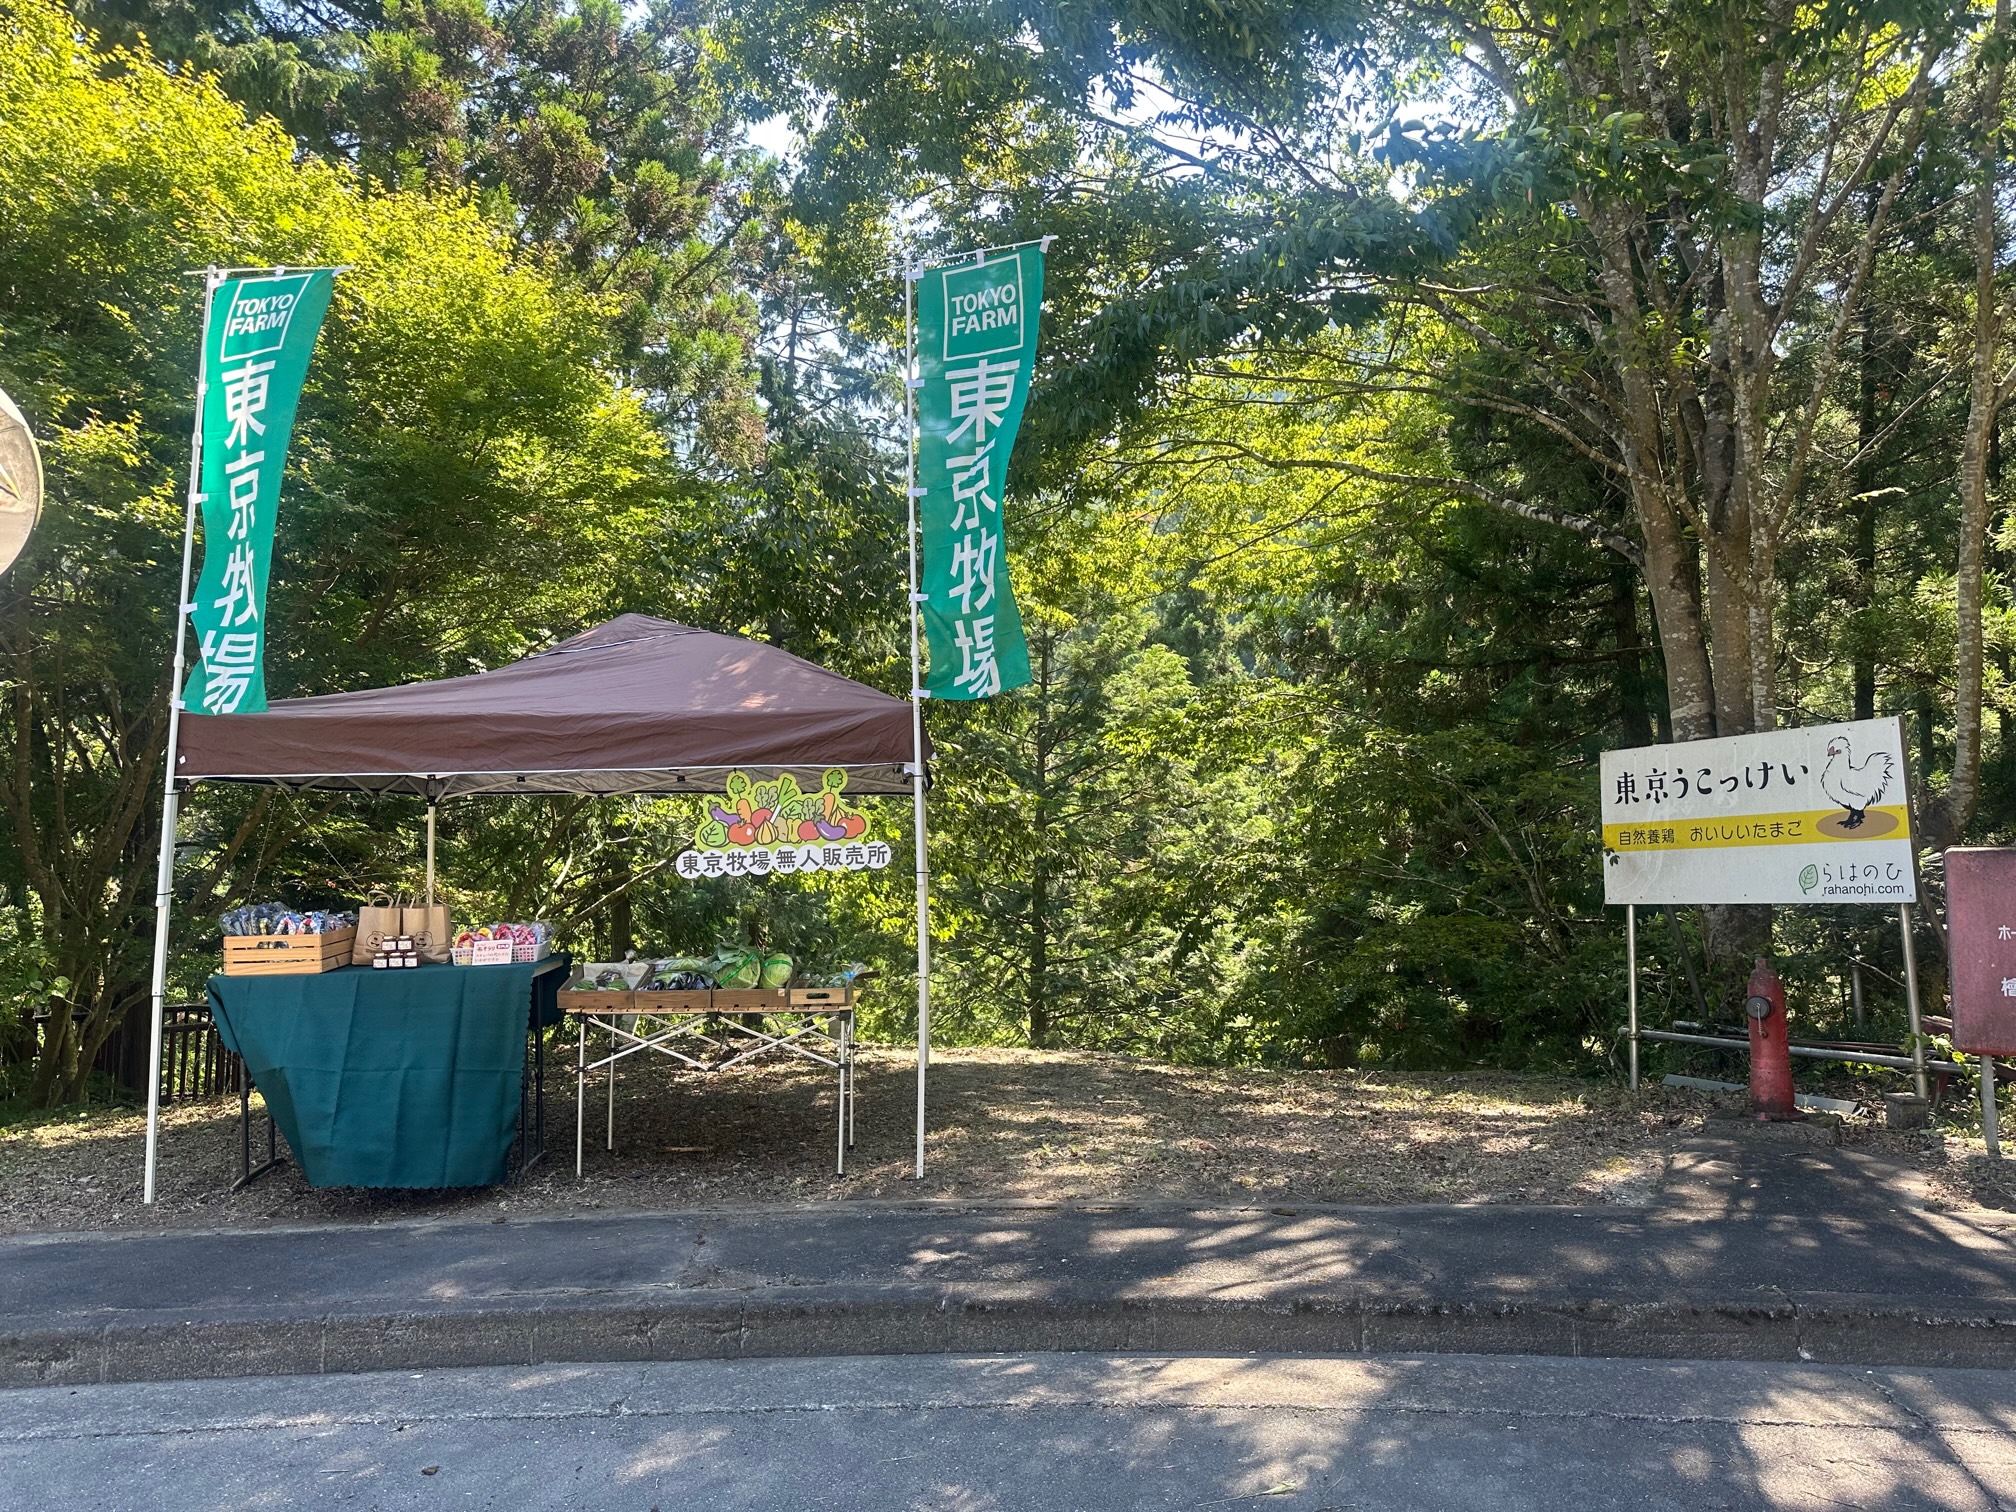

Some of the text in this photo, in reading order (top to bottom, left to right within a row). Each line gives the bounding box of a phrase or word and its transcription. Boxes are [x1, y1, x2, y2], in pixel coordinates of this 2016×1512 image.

[236, 293, 294, 318] TOKYO
[951, 284, 1017, 316] TOKYO
[228, 309, 288, 338] FARM
[951, 306, 1018, 338] FARM
[201, 359, 276, 715] 東京牧場
[945, 358, 1021, 698] 東京牧場
[1614, 761, 1809, 805] 東京うこっけい
[1619, 820, 1803, 846] 自然養鶏 おいしいたまご
[1823, 862, 1903, 883] らはのひ
[1823, 883, 1905, 895] rahanohi.com
